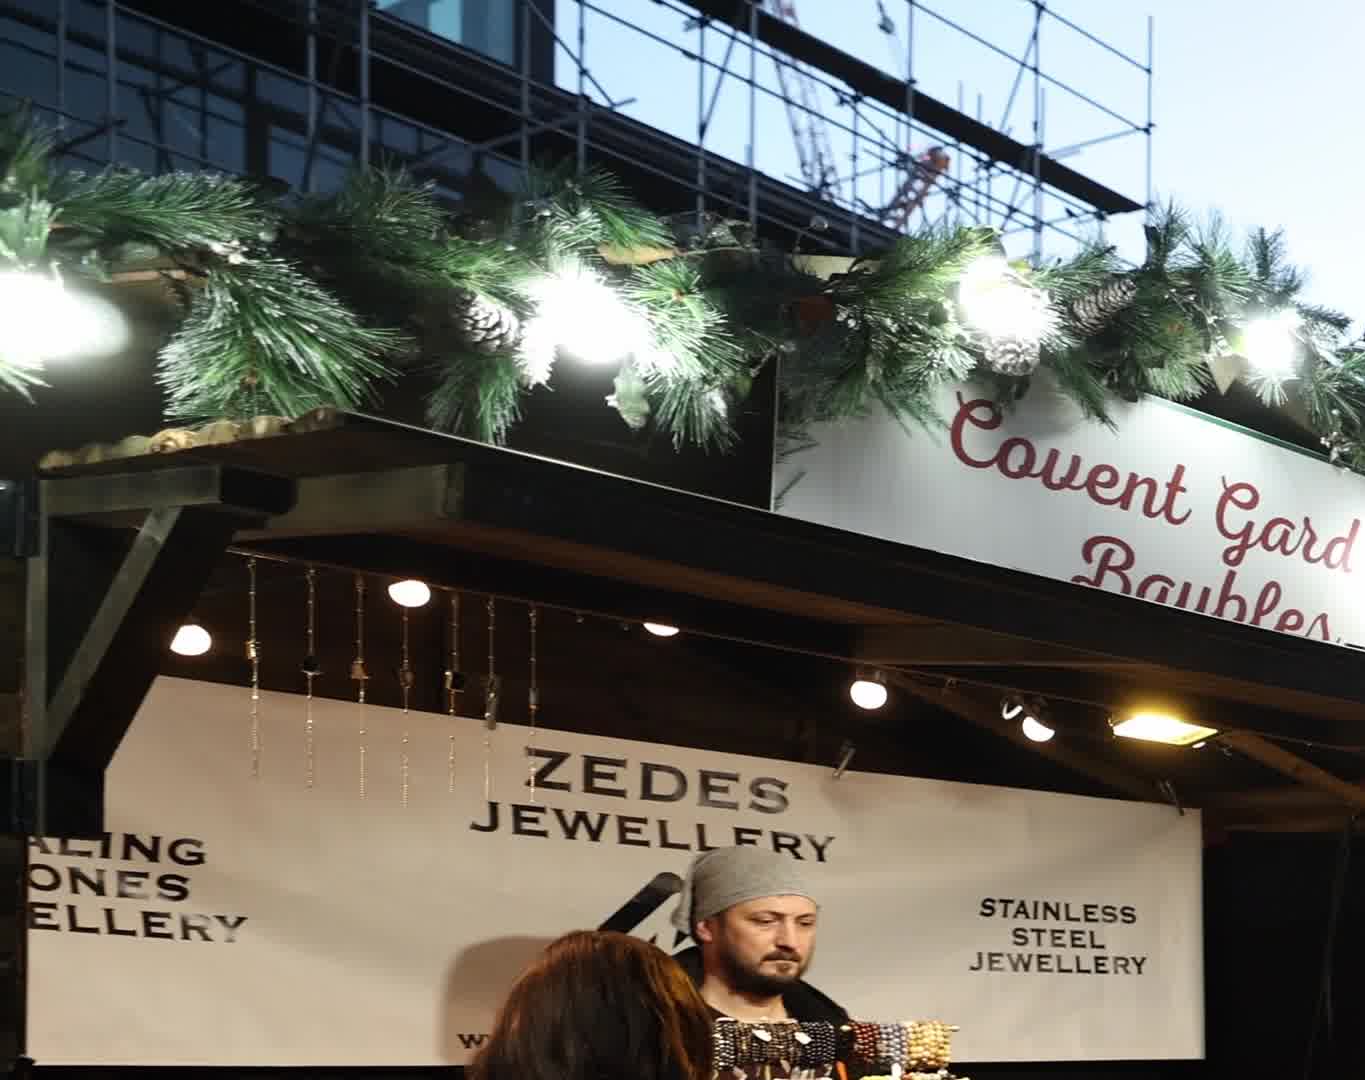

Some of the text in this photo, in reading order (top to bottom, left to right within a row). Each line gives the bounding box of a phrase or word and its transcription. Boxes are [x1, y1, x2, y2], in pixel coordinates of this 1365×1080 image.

[951, 391, 1192, 526] Covent
[524, 746, 790, 815] ZEDES
[470, 801, 835, 863] JEWELLERY
[28, 863, 192, 902] ONES
[28, 901, 249, 944] ELLERY
[979, 897, 1137, 924] STAINLESS
[1011, 927, 1106, 950] STEEL
[969, 951, 1147, 976] JEWELLERY
